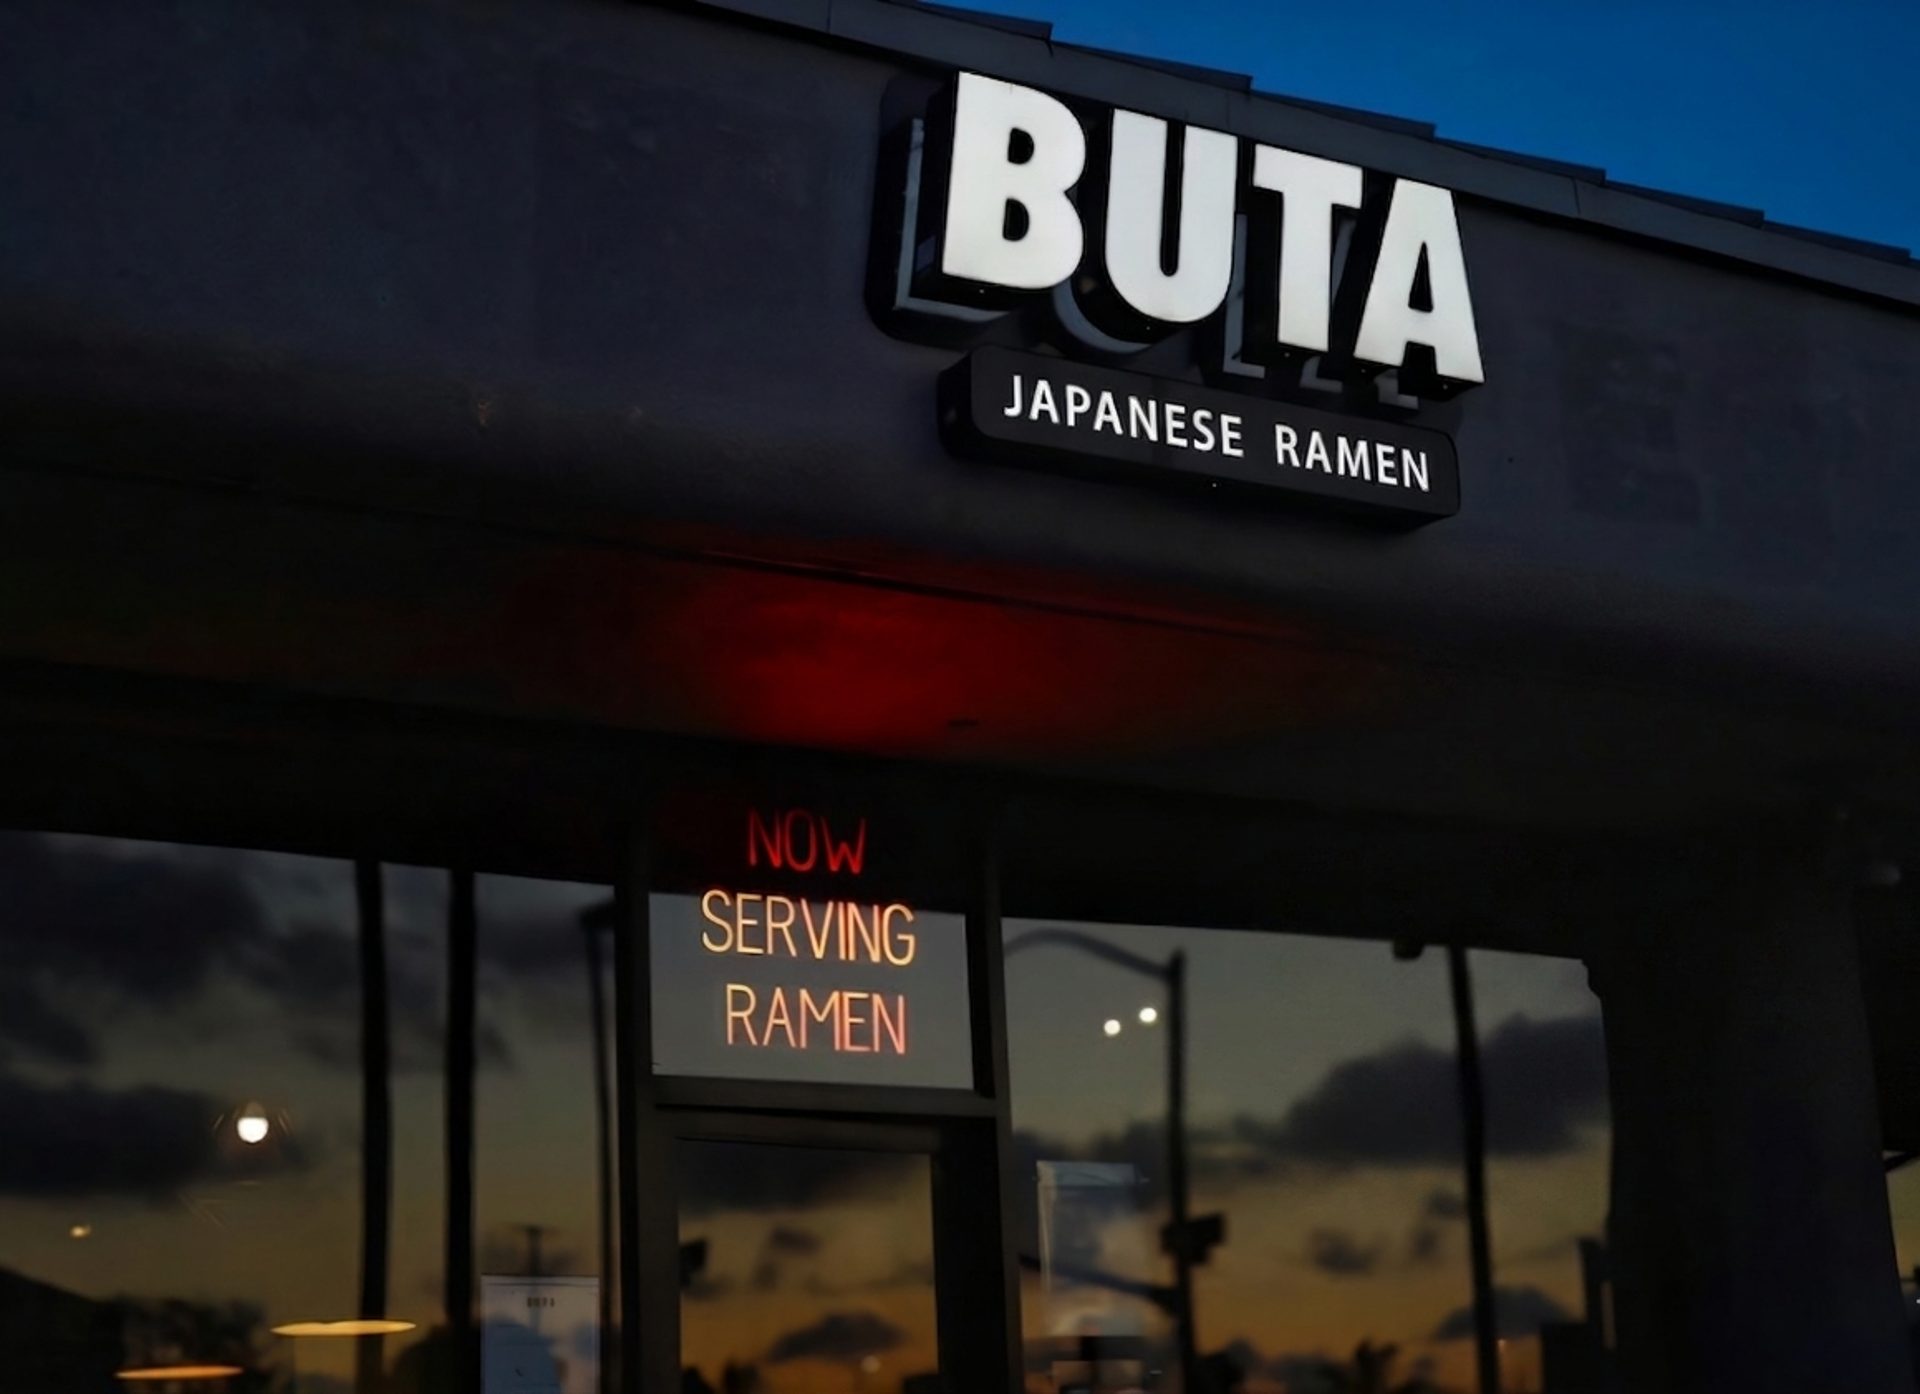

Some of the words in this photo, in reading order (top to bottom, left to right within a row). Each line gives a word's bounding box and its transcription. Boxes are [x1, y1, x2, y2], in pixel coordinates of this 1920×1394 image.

[942, 71, 1485, 383] BUTA
[1003, 374, 1245, 458] JAPANESE
[1274, 423, 1430, 493] RAMEN
[748, 808, 868, 874] NOW
[701, 888, 917, 966] SERVING
[725, 982, 906, 1055] RAMEN
